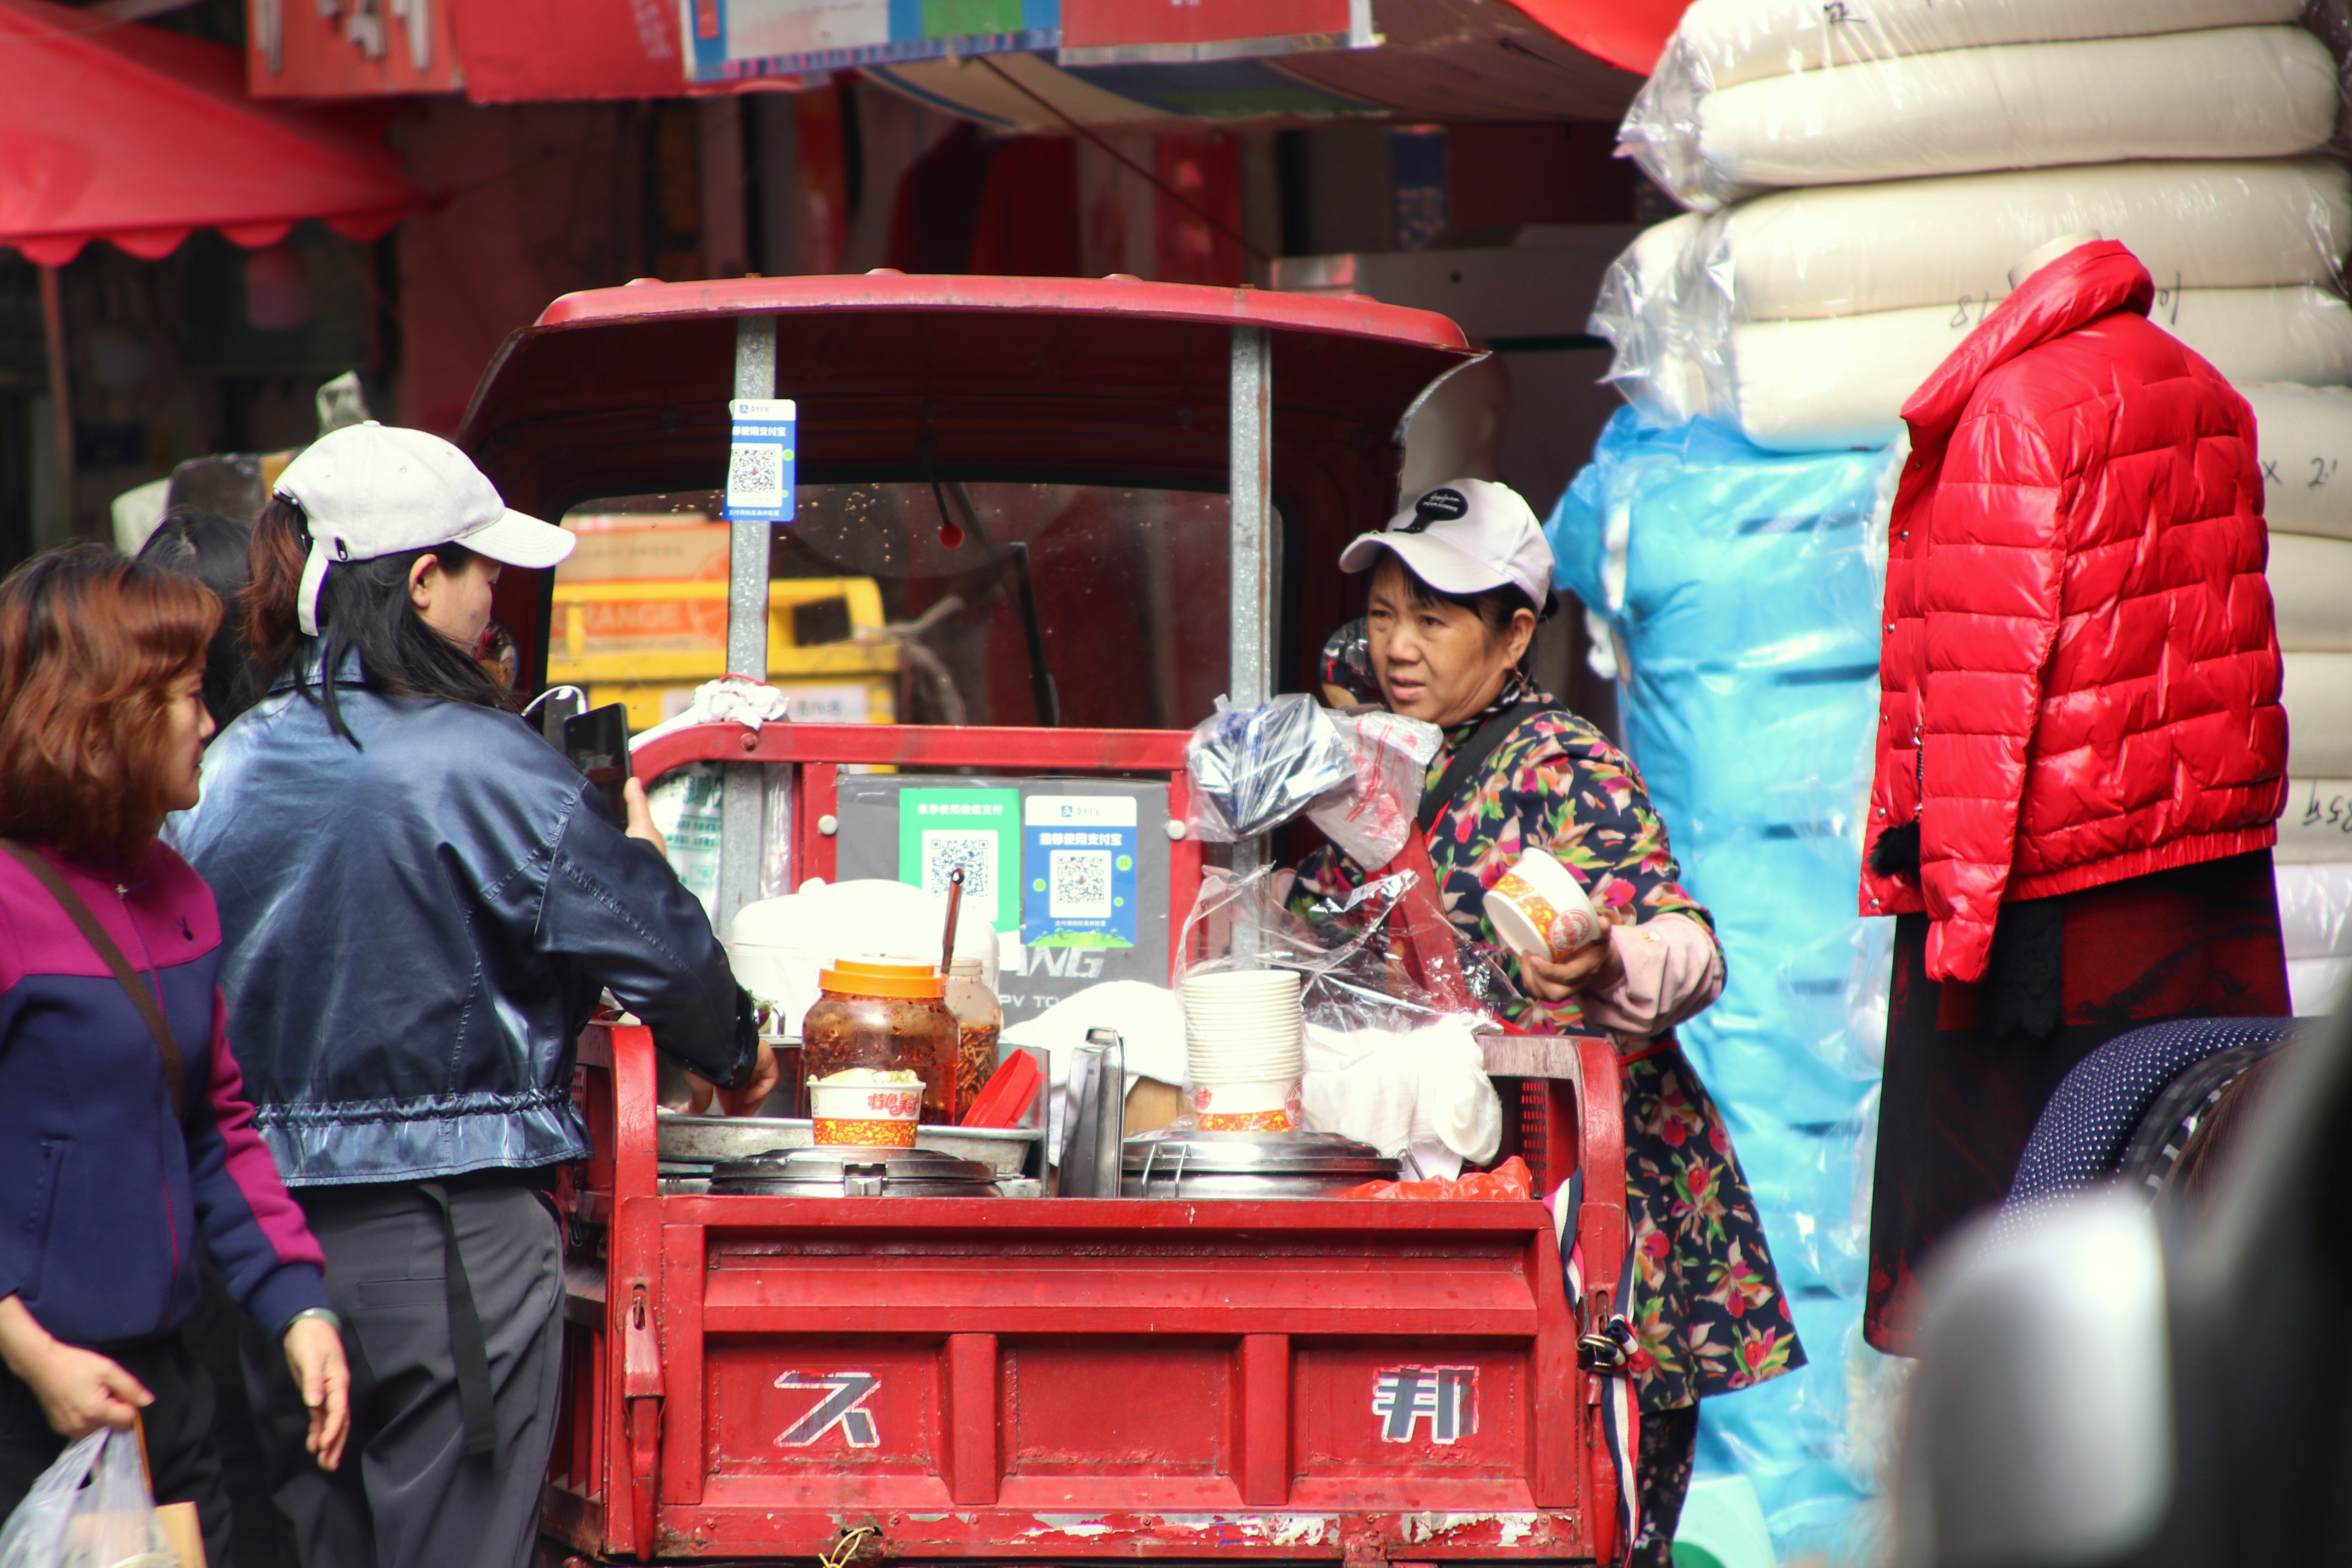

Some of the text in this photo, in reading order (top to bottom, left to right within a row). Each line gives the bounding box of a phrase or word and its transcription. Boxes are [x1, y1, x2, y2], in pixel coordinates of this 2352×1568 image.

[917, 804, 1003, 815] 推荐使用微信支付
[1075, 807, 1101, 816] 支付宝
[1040, 832, 1122, 846] 推荐使用支付宝
